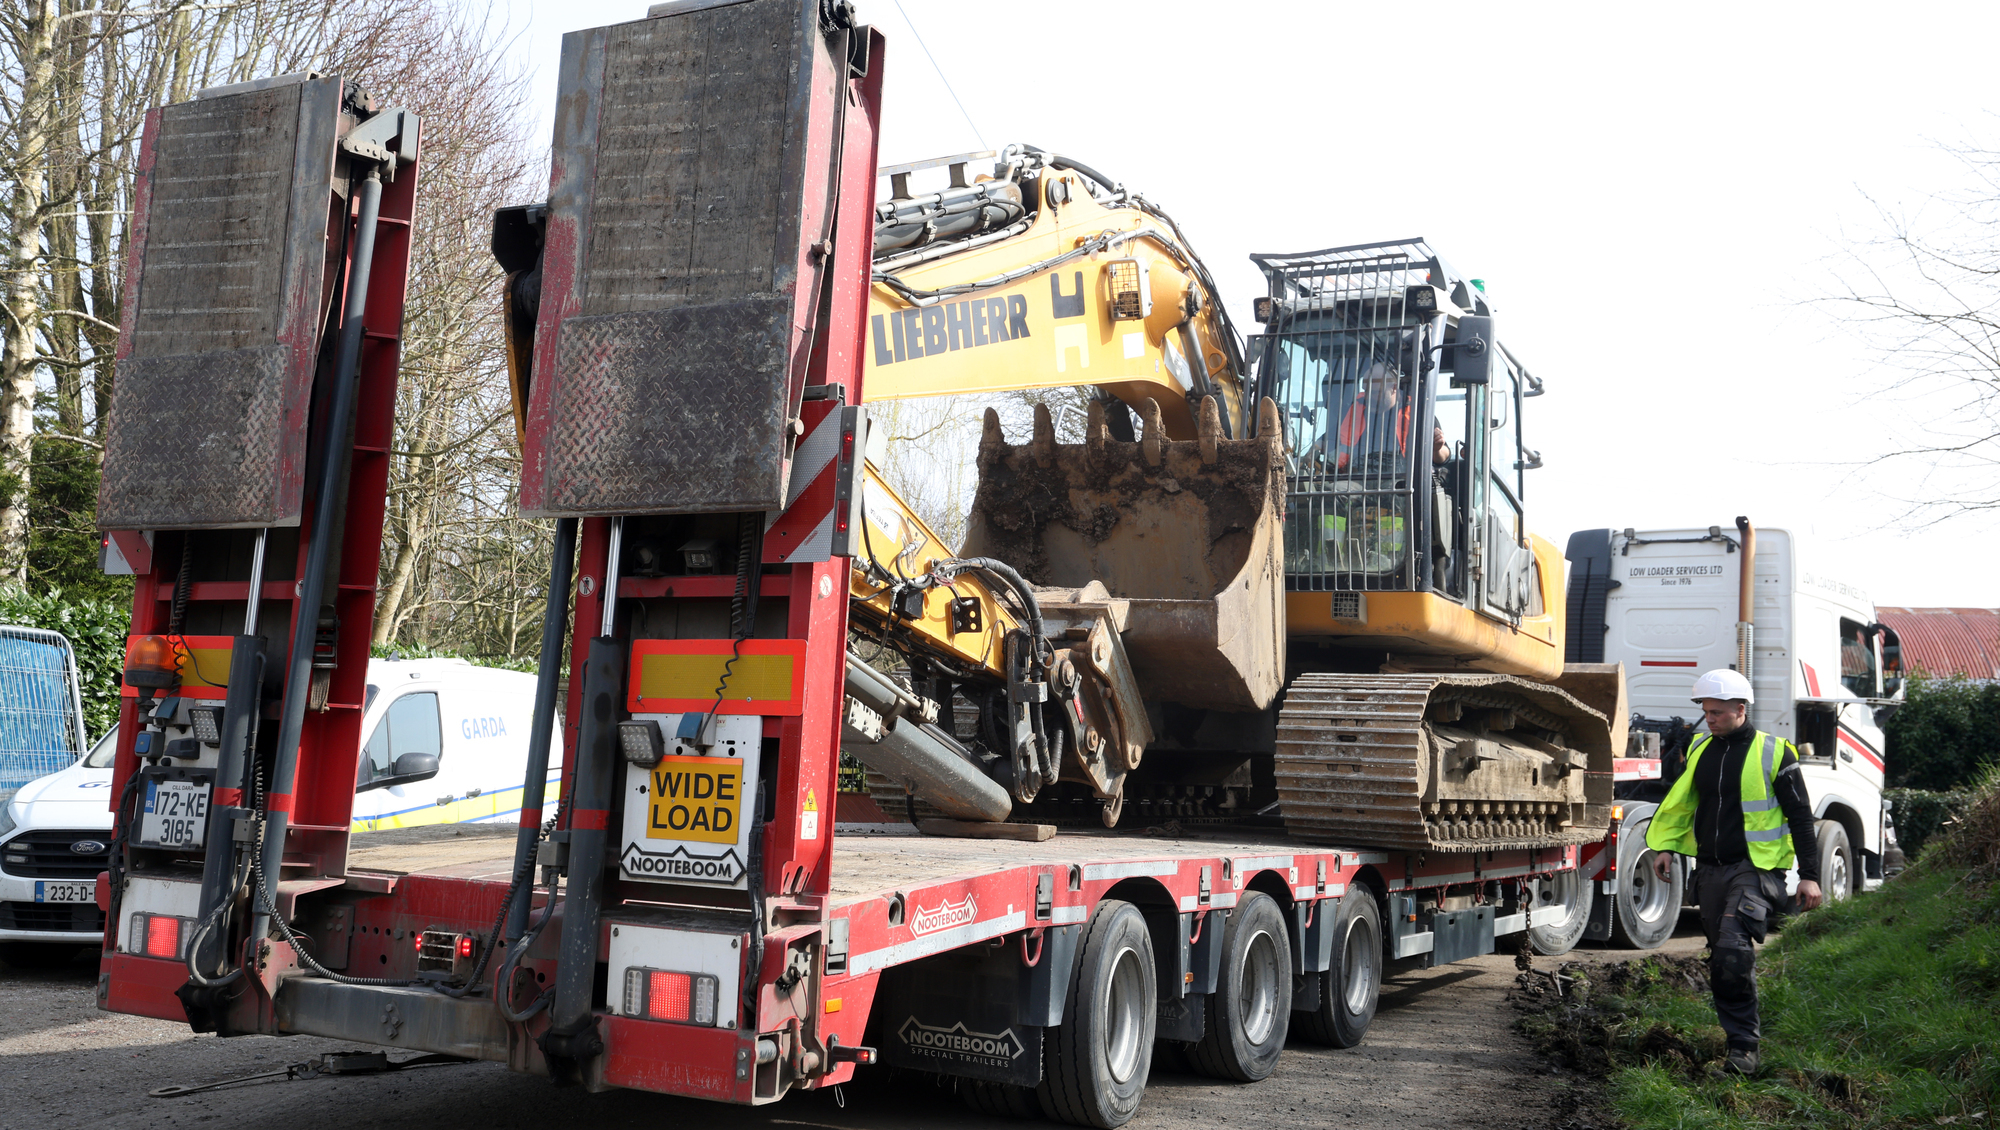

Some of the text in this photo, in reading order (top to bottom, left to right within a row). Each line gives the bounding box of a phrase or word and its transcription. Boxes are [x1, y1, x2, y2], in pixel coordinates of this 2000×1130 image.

[871, 293, 1031, 367] LIEBHERR
[1630, 565, 1723, 577] LOW LOADER SERVICES LTD
[1661, 577, 1692, 586] Since 1976
[1636, 624, 1707, 635] VOLVO
[462, 716, 507, 740] GARDA
[654, 771, 736, 800] WIDE
[155, 791, 207, 818] 172-KE
[652, 804, 733, 832] LOAD
[160, 819, 195, 844] 3185
[76, 842, 96, 852] Ford
[630, 856, 732, 878] NOOTEBOOM
[50, 886, 96, 901] 232-D-
[917, 908, 971, 932] NOOTEBOOM
[910, 1029, 1010, 1057] NOOTEBOOM
[911, 1047, 1009, 1068] SPECIAL TRAILERS
